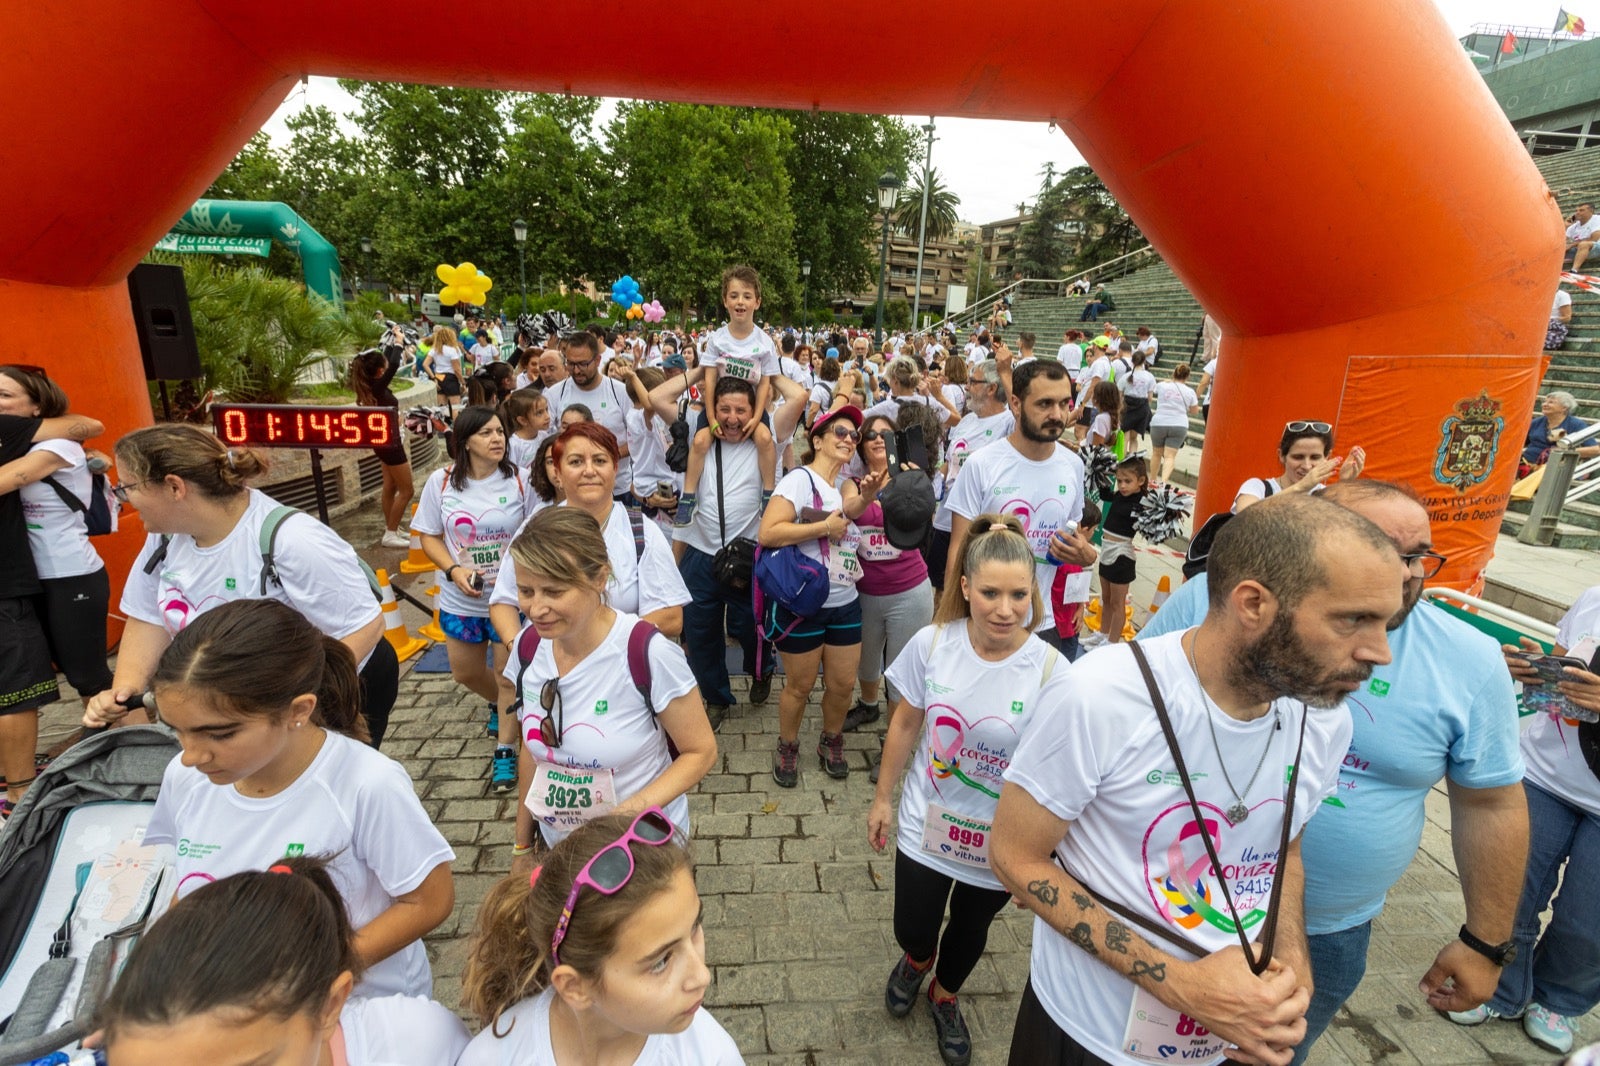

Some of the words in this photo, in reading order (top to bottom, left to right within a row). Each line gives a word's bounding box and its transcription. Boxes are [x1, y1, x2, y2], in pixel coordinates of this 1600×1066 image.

[180, 234, 265, 246] fundación
[223, 245, 261, 253] GRANADA
[725, 363, 751, 379] 3831
[1452, 510, 1469, 521] de
[471, 550, 500, 564] 1884
[976, 741, 990, 753] Un
[991, 748, 1008, 758] solo
[975, 761, 1002, 777] 5415
[544, 783, 593, 809] 3923
[948, 824, 985, 848] 899
[954, 849, 987, 863] vithas
[1240, 846, 1260, 863] Un
[1234, 876, 1272, 896] 5415
[1181, 1040, 1225, 1059] vithas
